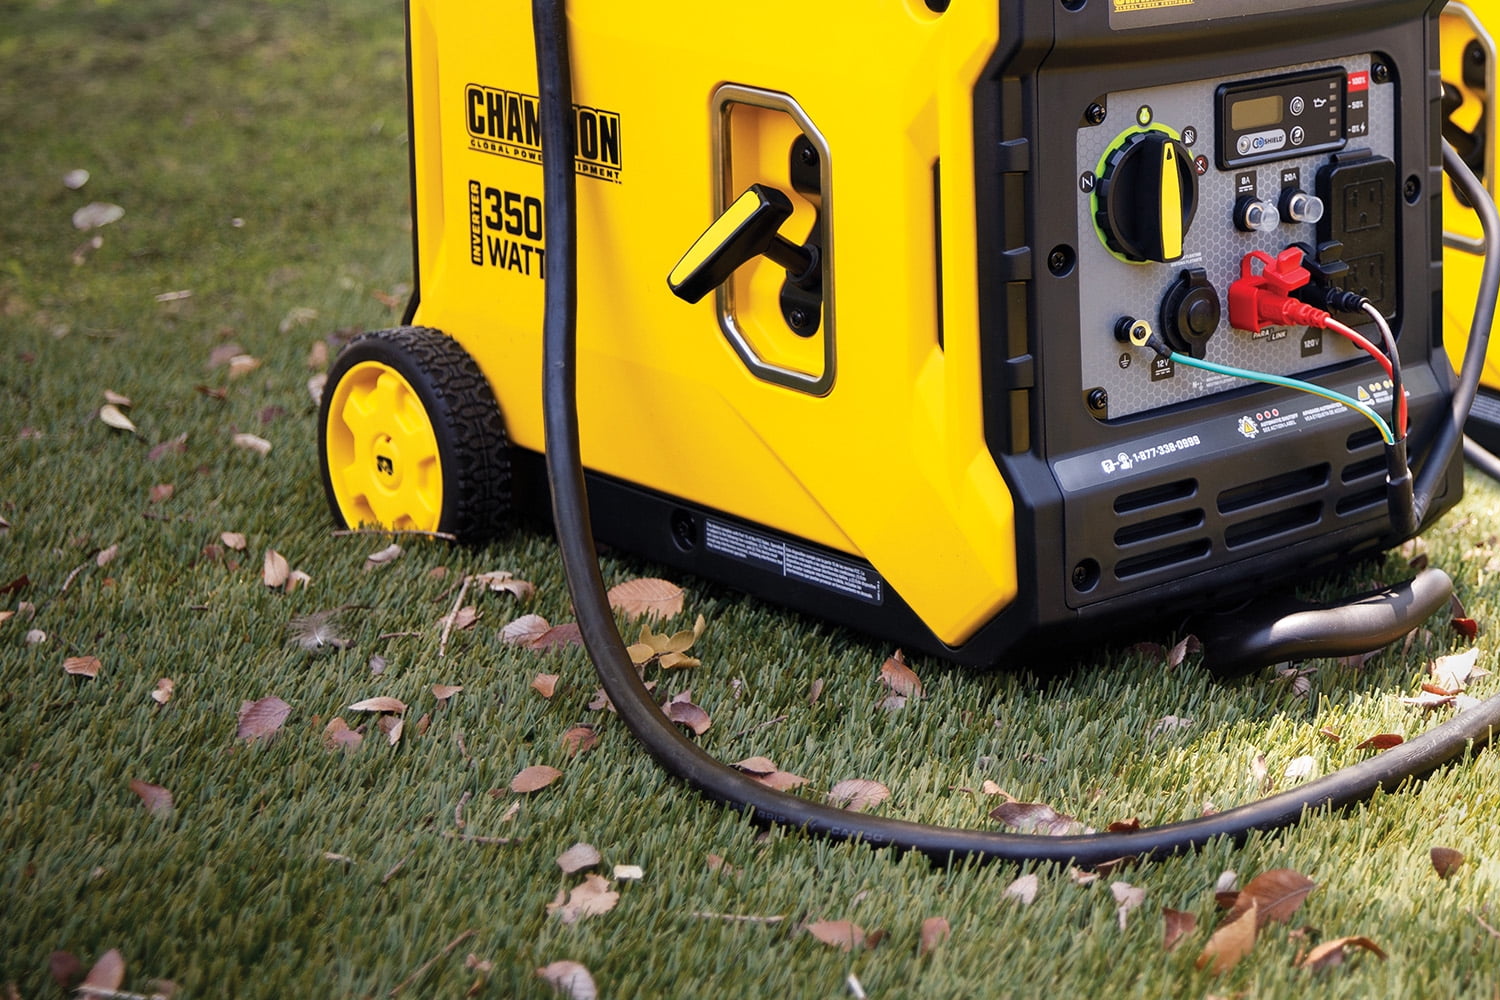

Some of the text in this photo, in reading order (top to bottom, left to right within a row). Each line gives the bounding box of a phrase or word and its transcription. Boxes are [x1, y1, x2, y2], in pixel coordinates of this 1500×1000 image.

[468, 87, 619, 167] CHAMION
[513, 148, 544, 162] POWE
[577, 162, 619, 179] IPMENT
[470, 182, 482, 263] INVERTER
[485, 186, 543, 242] 350
[487, 234, 544, 280] WATT
